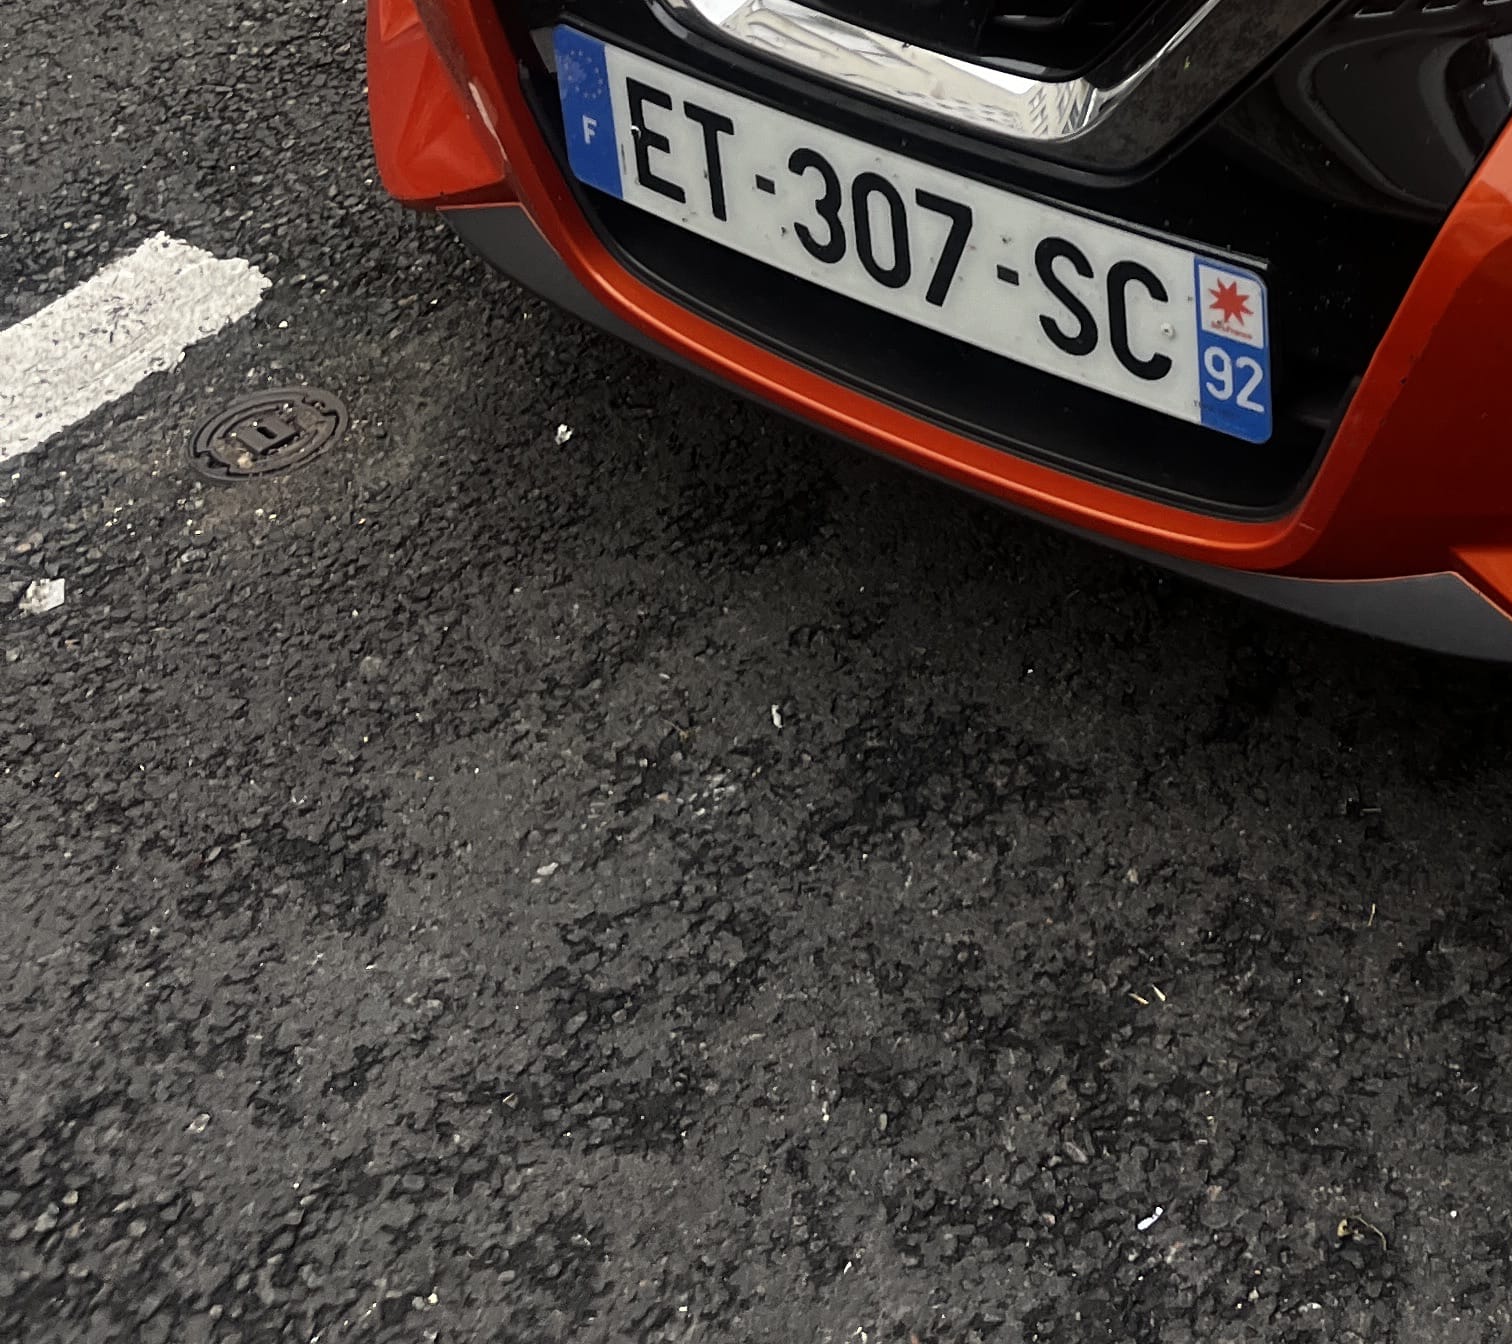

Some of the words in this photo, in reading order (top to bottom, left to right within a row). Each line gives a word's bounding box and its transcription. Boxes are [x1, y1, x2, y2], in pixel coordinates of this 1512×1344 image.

[582, 114, 597, 144] F
[626, 76, 1172, 381] ET-307-SC
[1204, 346, 1265, 412] 92
